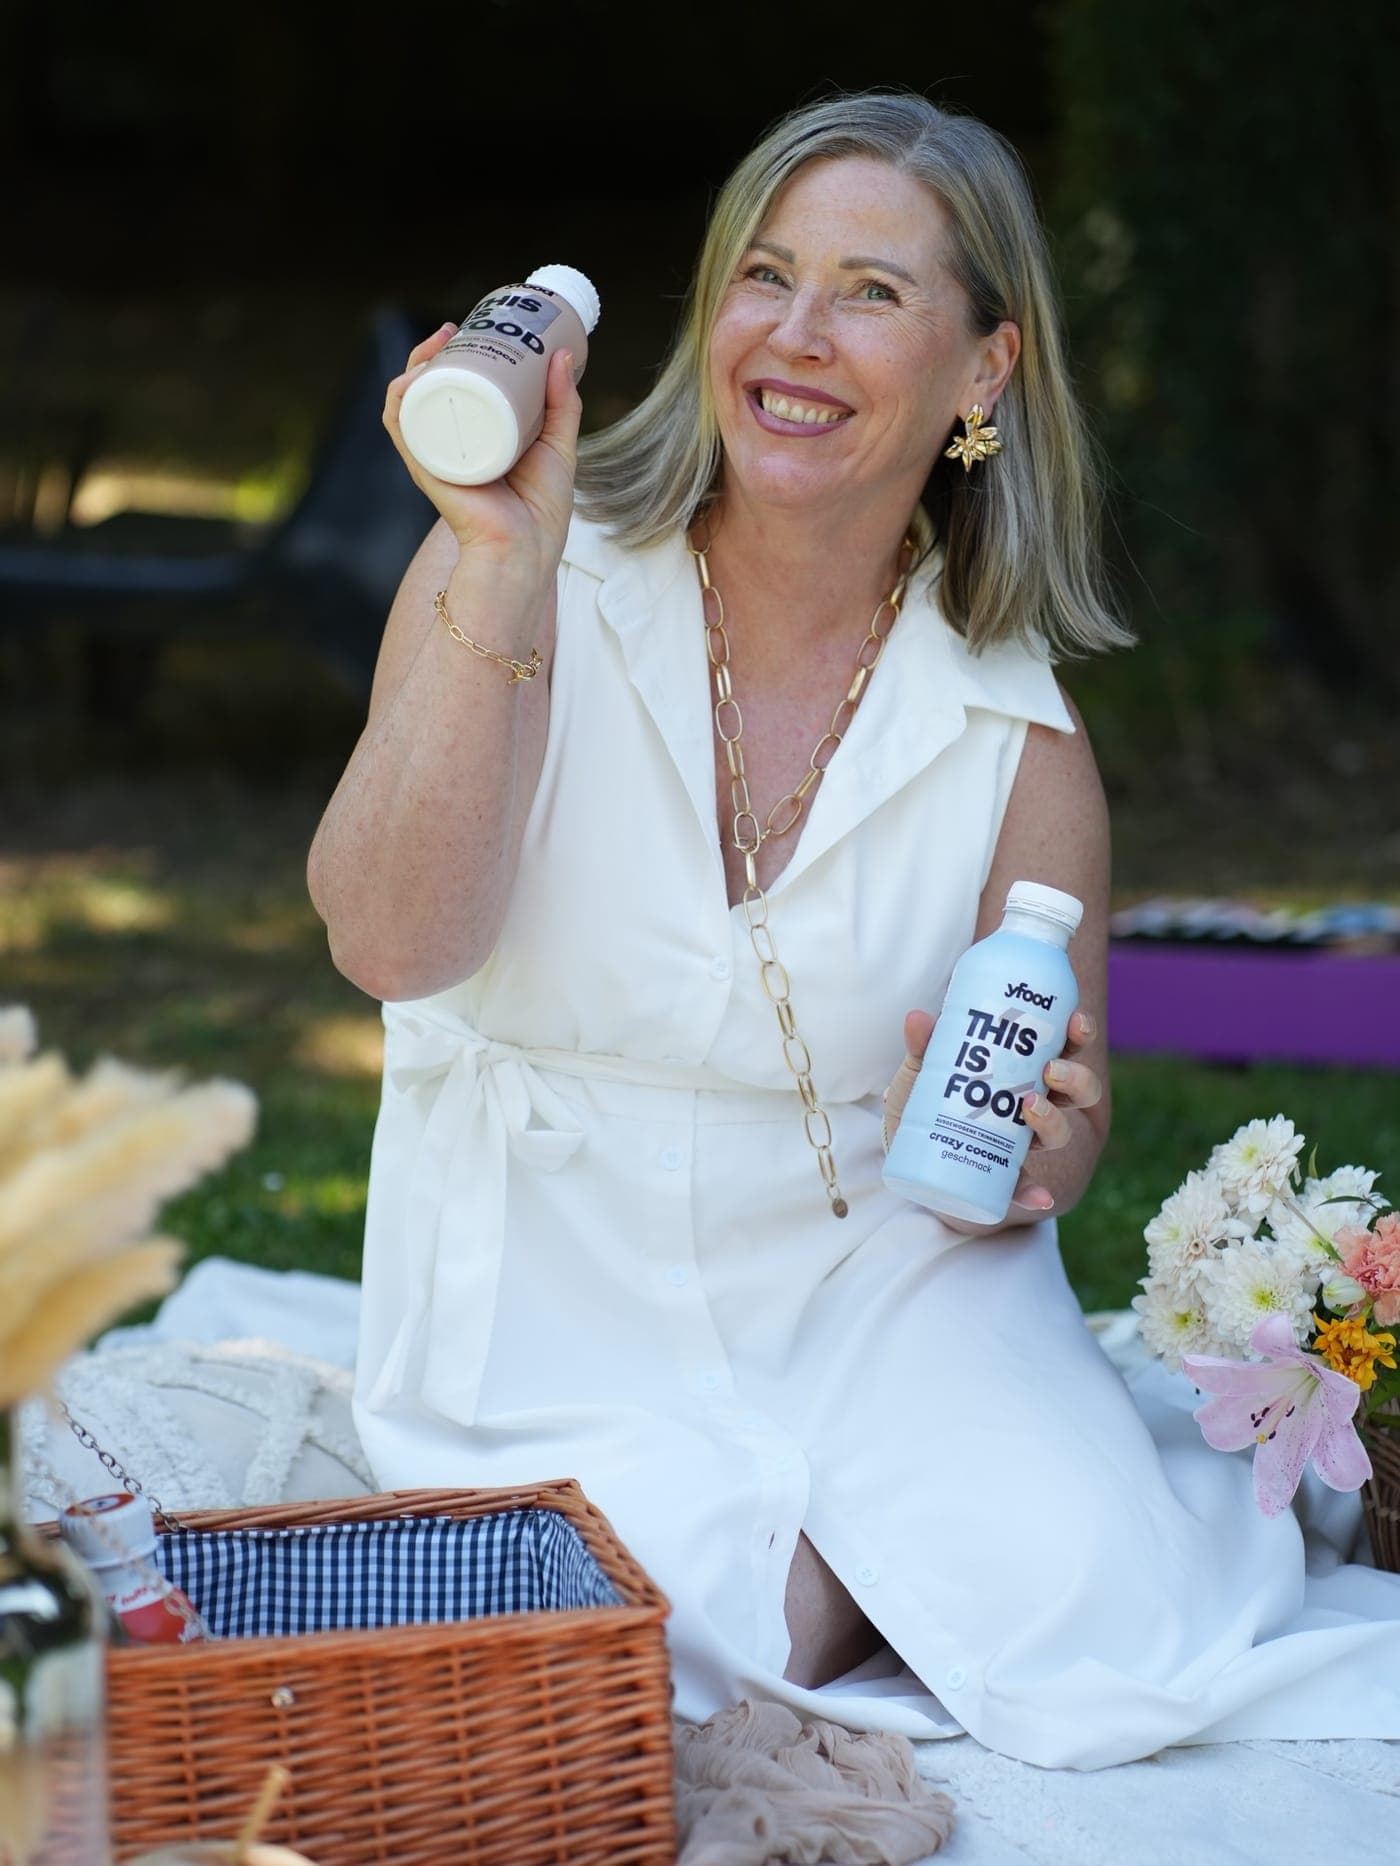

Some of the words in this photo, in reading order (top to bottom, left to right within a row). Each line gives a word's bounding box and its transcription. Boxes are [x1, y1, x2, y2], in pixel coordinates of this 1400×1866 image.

[480, 345, 517, 365] choco
[1004, 982, 1054, 1012] yfood
[967, 1008, 1038, 1057] THIS
[954, 1041, 991, 1073] IS
[929, 1131, 964, 1150] crazy
[965, 1144, 1009, 1168] coconut
[941, 1150, 993, 1175] geschmack
